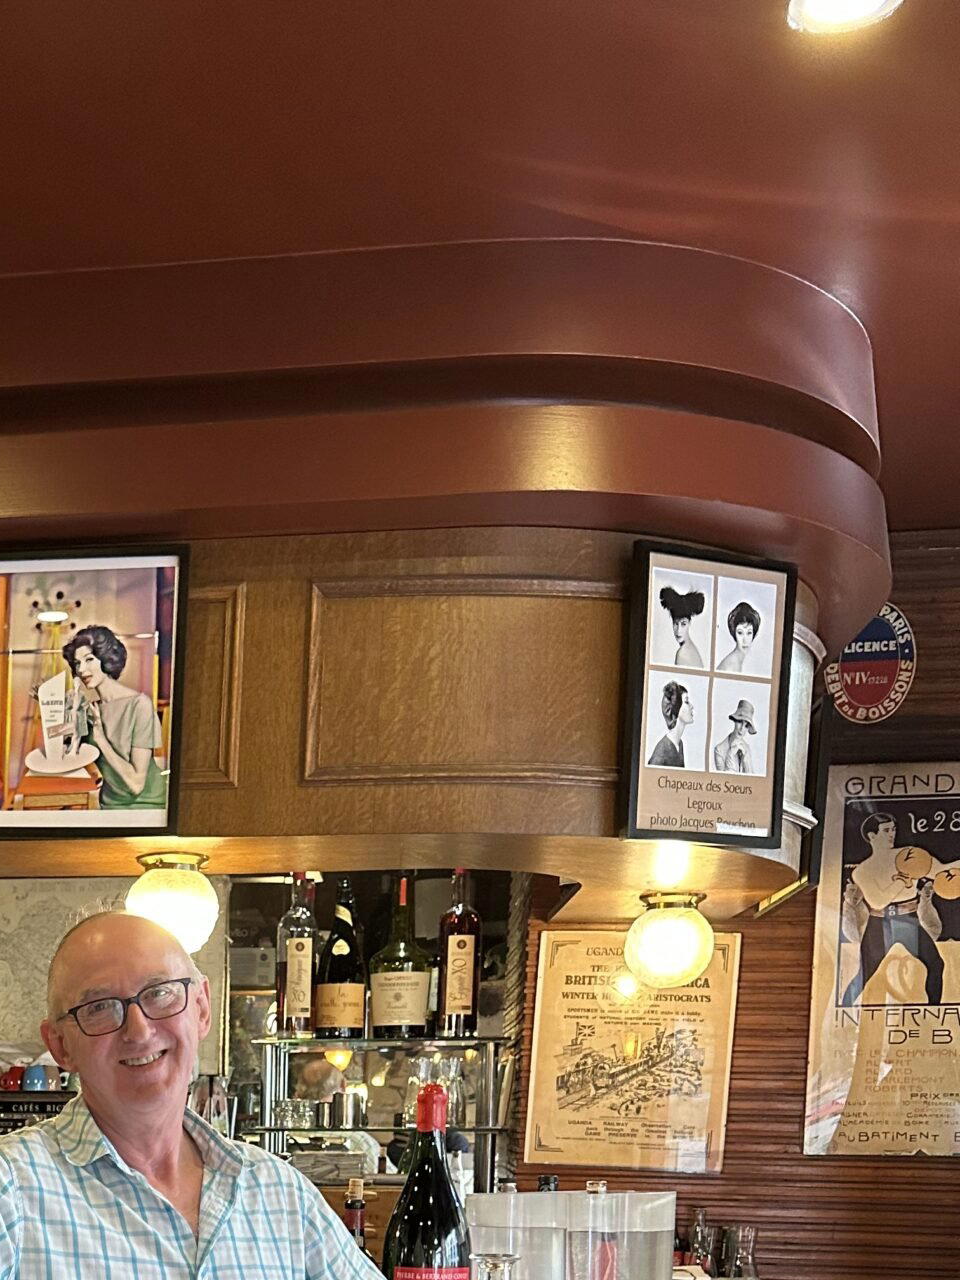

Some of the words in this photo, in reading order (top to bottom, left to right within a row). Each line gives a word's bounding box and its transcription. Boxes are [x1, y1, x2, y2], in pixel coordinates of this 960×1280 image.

[878, 604, 911, 644] PARIS
[844, 640, 897, 653] LICENCE
[826, 663, 849, 706] DEBIT
[855, 660, 913, 719] BOISSONS
[657, 775, 704, 794] Chapeaux
[706, 780, 722, 793] des
[723, 781, 753, 796] Soeurs
[844, 773, 955, 796] GRAND
[687, 796, 723, 813] Legroux
[650, 812, 678, 828] photo
[678, 814, 714, 831] Jacques
[908, 811, 929, 833] le
[586, 946, 624, 956] UGAND
[561, 991, 599, 1001] WINTER
[887, 1029, 920, 1045] DE
[910, 1092, 941, 1100] PRIX
[12, 1103, 40, 1112] CAFÉS
[858, 1131, 940, 1143] BATIMENT
